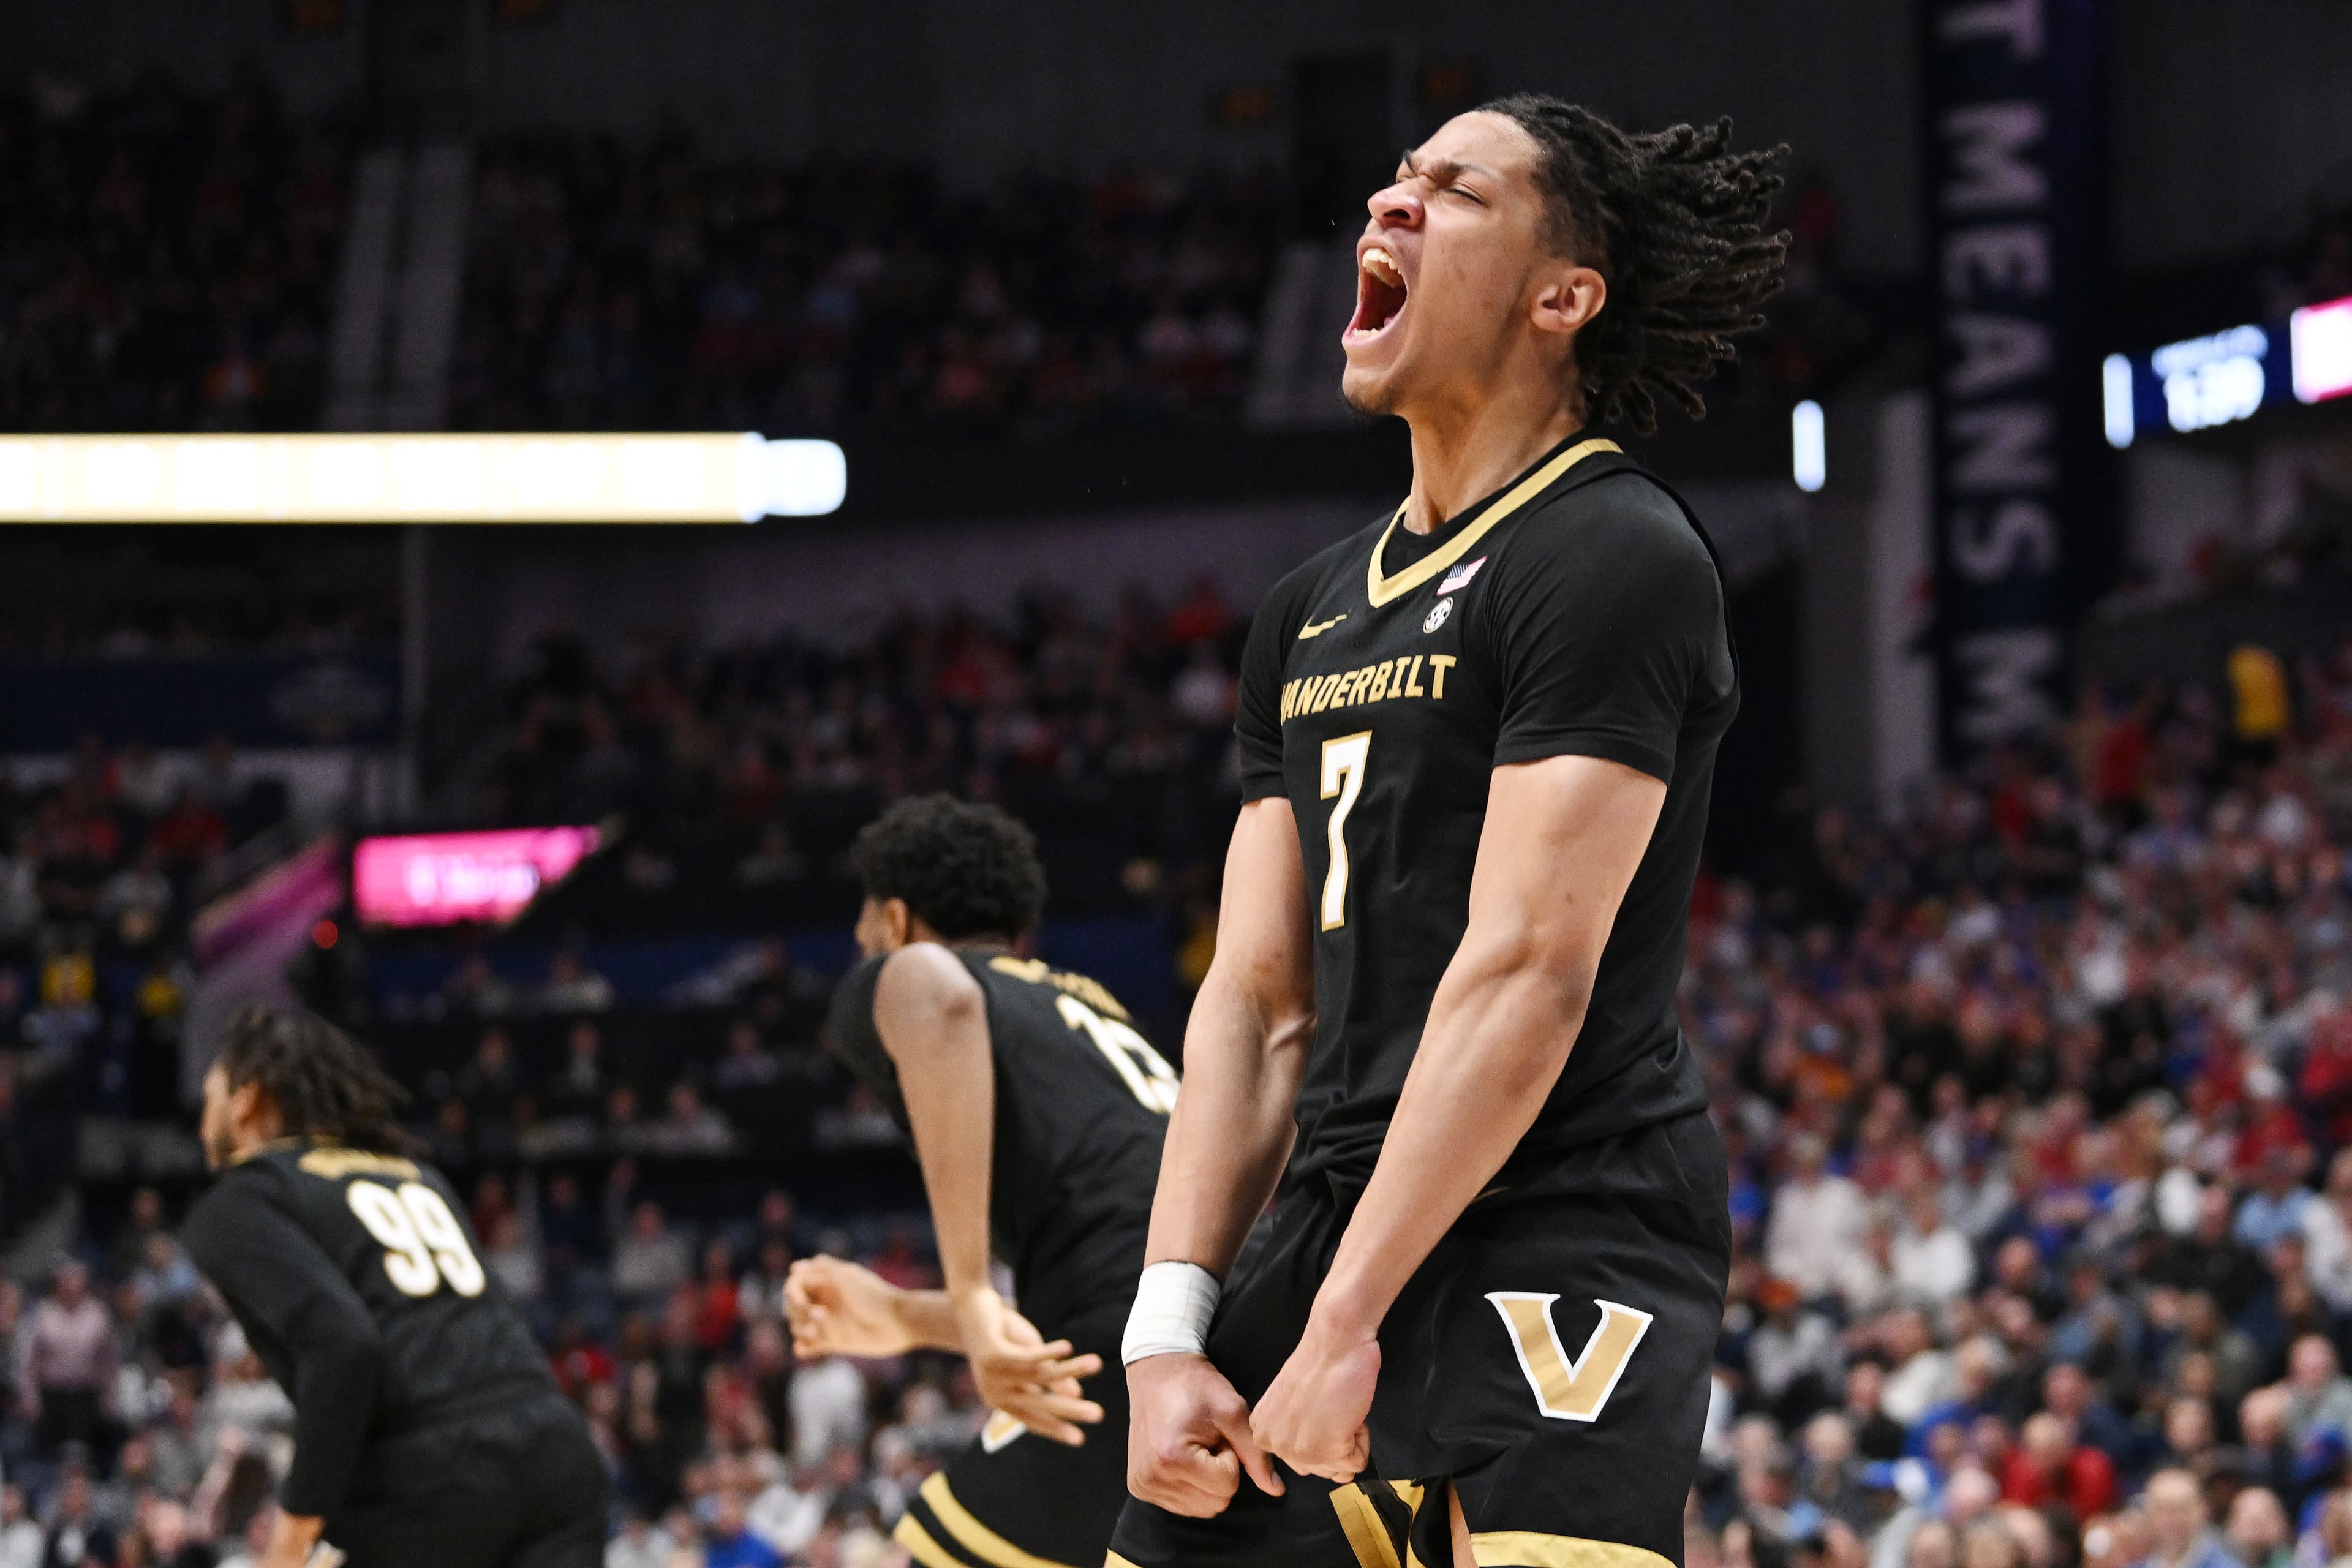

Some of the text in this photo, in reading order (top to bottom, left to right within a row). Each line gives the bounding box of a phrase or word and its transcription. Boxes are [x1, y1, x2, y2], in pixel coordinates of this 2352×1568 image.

[1939, 99, 2058, 583] MEANS
[1280, 654, 1457, 725] VANDERBILT
[1320, 729, 1373, 932] 7
[346, 1178, 486, 1298] 99
[1483, 1291, 1654, 1423] V
